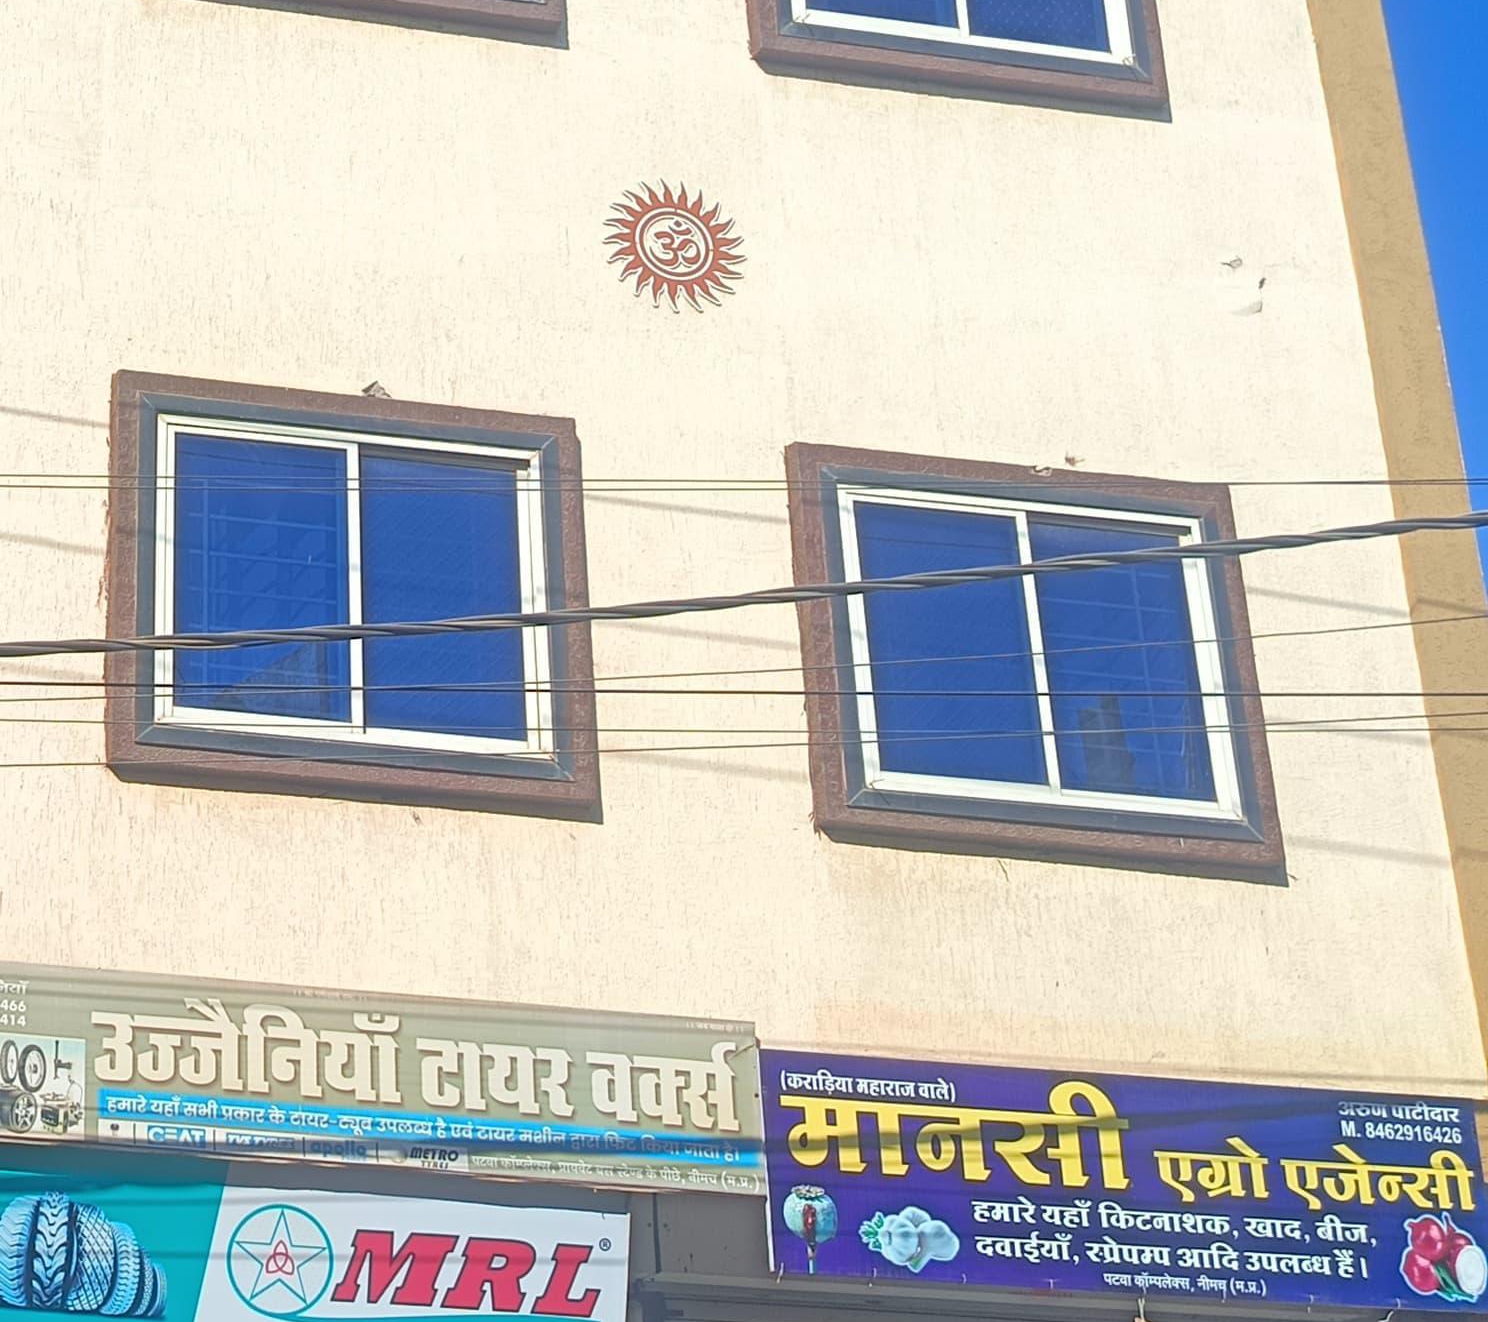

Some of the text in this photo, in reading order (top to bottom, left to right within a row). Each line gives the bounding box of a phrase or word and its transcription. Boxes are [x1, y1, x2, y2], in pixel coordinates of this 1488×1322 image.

[416, 1035, 575, 1118] टायर
[586, 1041, 741, 1132] वर्क्स
[856, 1077, 916, 1099] महाराज
[918, 1076, 956, 1104] वाले)
[106, 1093, 147, 1114] हमारे
[183, 1098, 218, 1120] सभी
[221, 1102, 266, 1124] प्रकार
[267, 1104, 287, 1125] के
[449, 1121, 473, 1140] एवं
[477, 1126, 515, 1143] टायर
[518, 1125, 566, 1146] मशीन
[640, 1133, 680, 1157] किया
[1338, 1099, 1461, 1123] अरुण पाटीदार
[780, 1079, 1476, 1211] मानसी एग्रो एजेन्सी
[1340, 1120, 1462, 1145] M. 8462916426
[310, 1139, 368, 1160] apollo
[409, 1146, 459, 1162] METRO
[971, 1196, 1377, 1247] हमारे यहाँ किटनाशक, खाद, बीज,
[330, 1228, 602, 1318] MRL
[1177, 1243, 1240, 1273] आदि
[1243, 1249, 1331, 1278] उपलब्ध
[1103, 1272, 1133, 1288] पटवा
[1197, 1274, 1227, 1293] नीमच
[1229, 1277, 1267, 1298] (म.प्र.)
